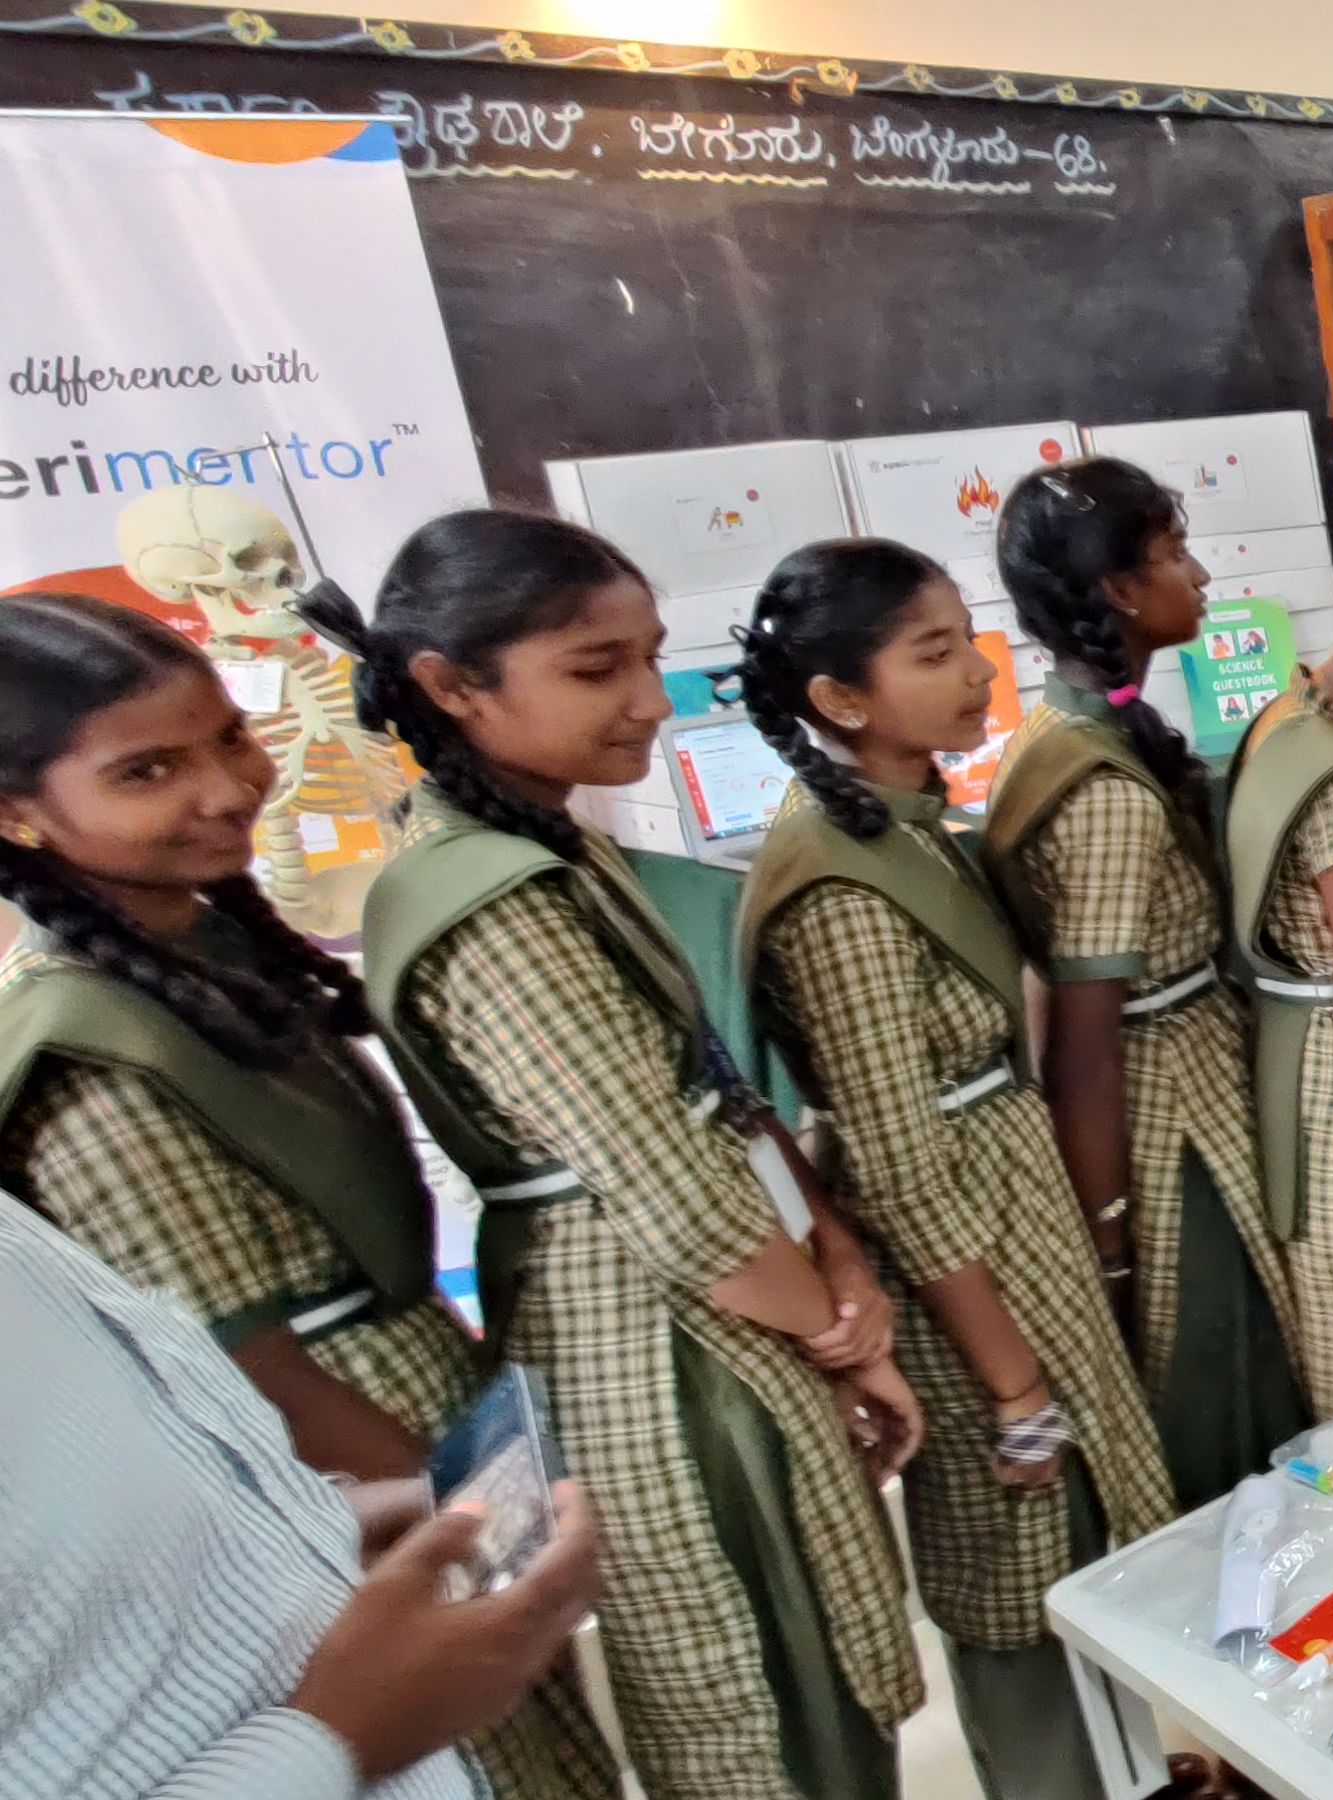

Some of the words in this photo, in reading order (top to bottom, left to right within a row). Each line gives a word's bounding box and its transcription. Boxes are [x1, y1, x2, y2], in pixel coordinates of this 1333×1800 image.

[10, 355, 221, 406] difference
[232, 348, 319, 385] with
[1219, 659, 1265, 675] SCIENCE
[1213, 674, 1277, 692] QUESTBOOK
